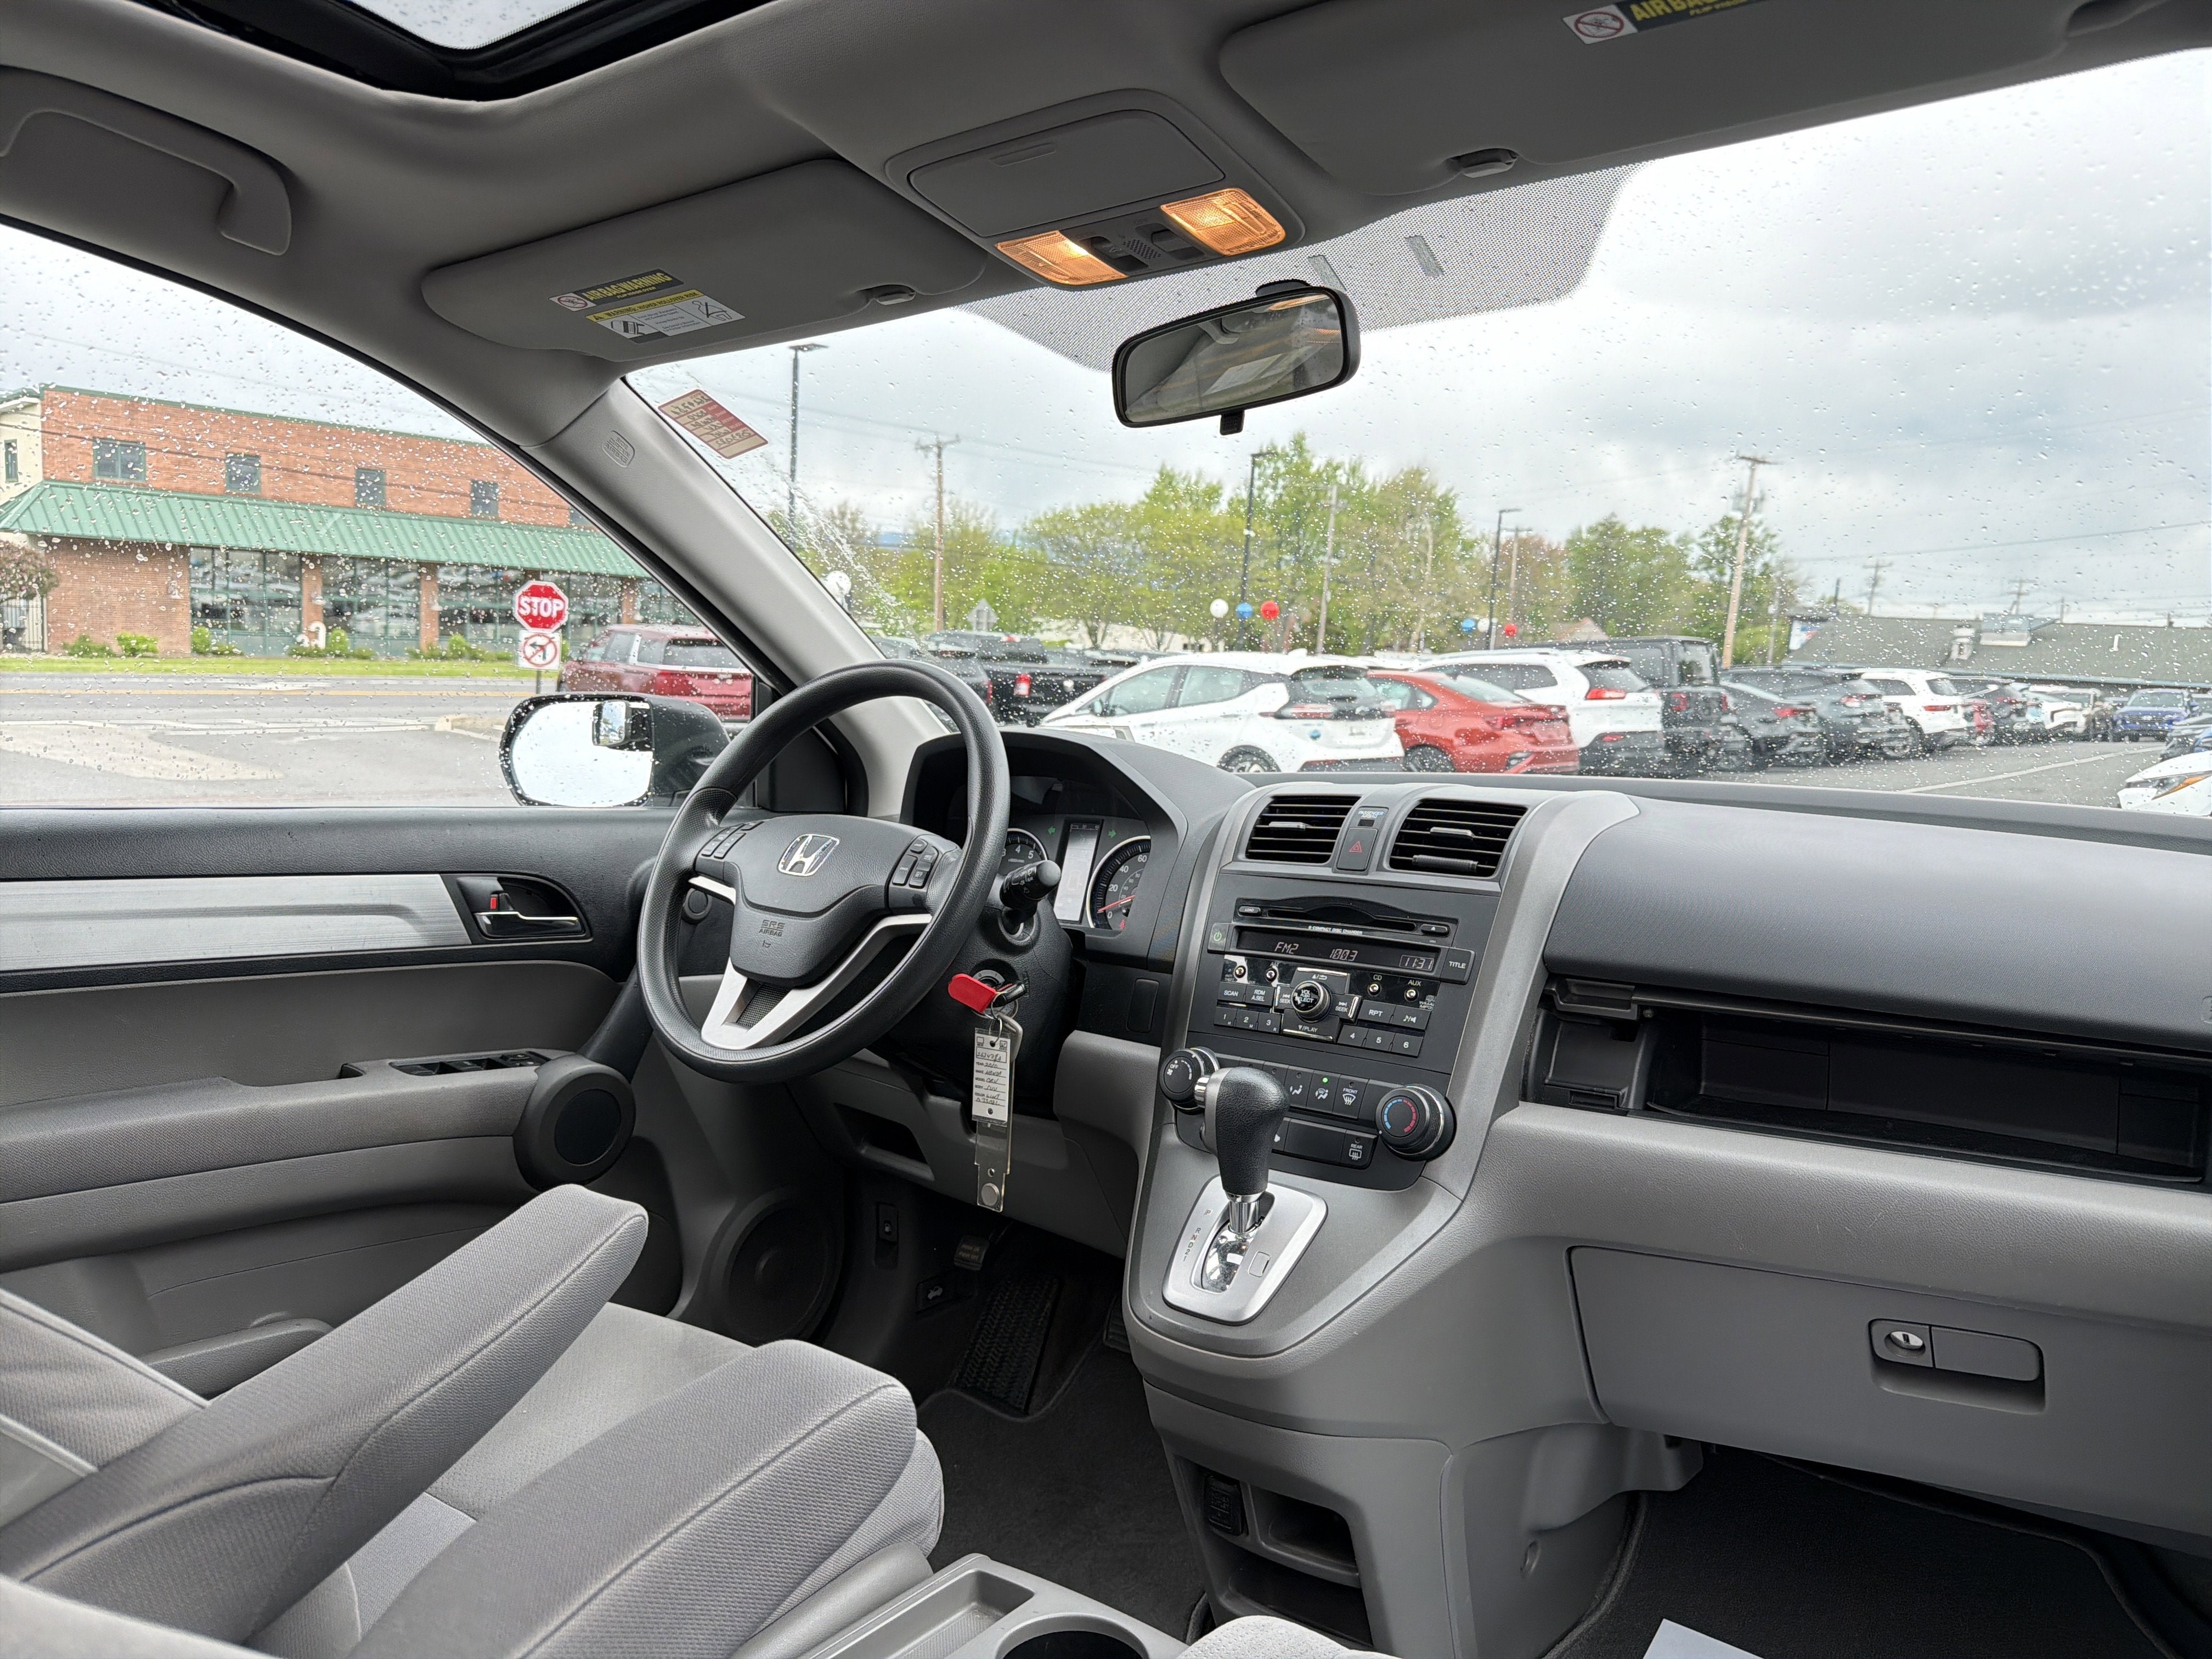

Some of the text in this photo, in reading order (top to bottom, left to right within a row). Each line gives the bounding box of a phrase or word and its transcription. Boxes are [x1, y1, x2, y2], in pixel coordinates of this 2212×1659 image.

[582, 272, 673, 301] AIRBAG WARNING
[518, 596, 564, 618] STOP
[1015, 845, 1021, 854] 4
[1028, 850, 1034, 859] 5
[1137, 855, 1147, 863] 60
[1119, 865, 1129, 873] 40
[1108, 884, 1119, 892] 20
[761, 919, 785, 929] SRS
[759, 928, 782, 937] AIRBAG
[1274, 941, 1299, 955] FM2
[1404, 957, 1434, 970] 11:31
[1448, 961, 1466, 969] TITLE
